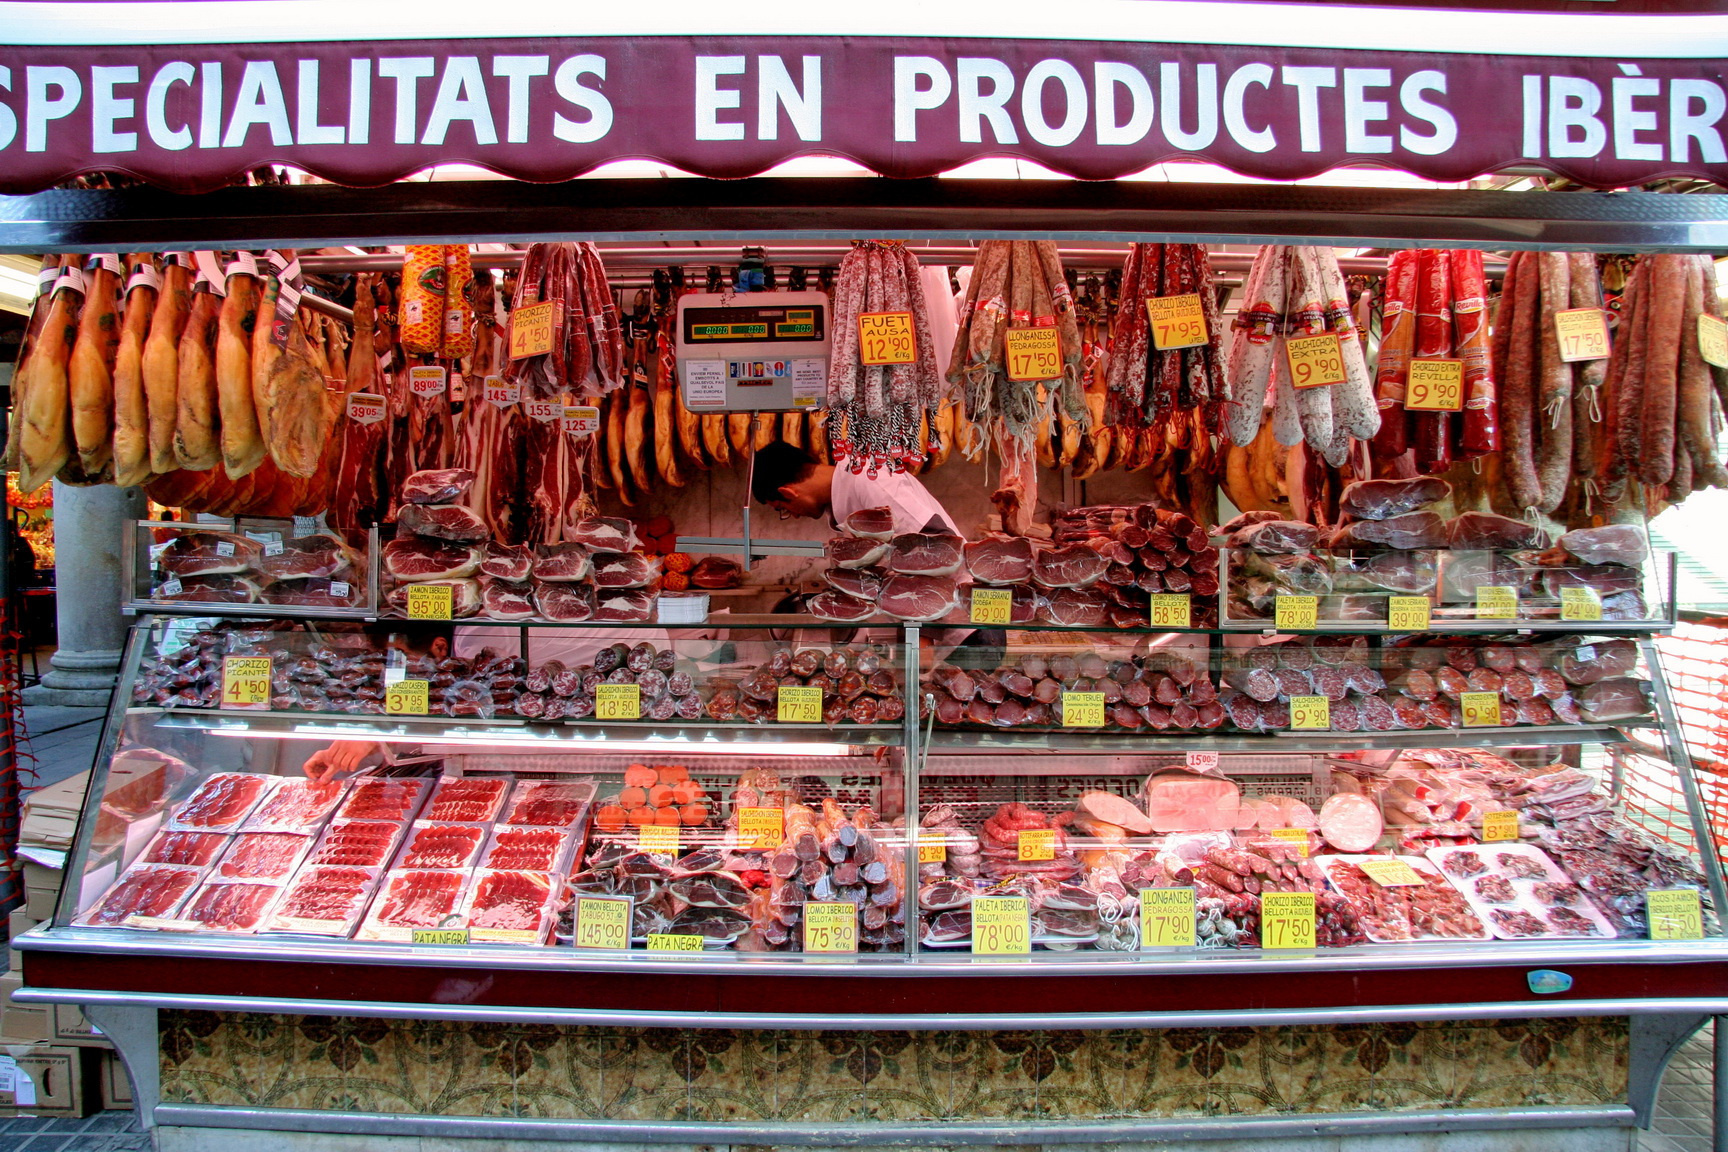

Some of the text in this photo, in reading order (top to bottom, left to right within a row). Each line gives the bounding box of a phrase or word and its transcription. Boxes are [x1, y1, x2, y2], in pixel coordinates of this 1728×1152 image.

[695, 55, 822, 141] EN
[894, 56, 1458, 156] PRODUCTES
[1150, 298, 1175, 310] CHORIZO
[514, 304, 551, 320] CHORIZO
[1152, 310, 1175, 321] BELLOTA
[515, 315, 549, 328] PICANTE
[862, 316, 908, 329] FUET
[866, 327, 910, 337] AUSA
[1009, 331, 1056, 342] LLONGANISSA
[1158, 321, 1201, 345] 7'95
[516, 326, 549, 352] 4'50
[1289, 337, 1336, 351] SALCHICHON
[1564, 333, 1603, 355] 17'50
[868, 337, 910, 360] 12'90
[1010, 342, 1056, 350] PEDRAGOSSA
[894, 352, 910, 360] €/Kg
[1292, 348, 1337, 359] EXTRA
[1013, 353, 1057, 375] 17'50
[1296, 358, 1339, 383] 9'90
[1412, 363, 1460, 372] CHORIZO EXTRA
[1412, 373, 1459, 381] REVILLA
[414, 380, 437, 392] 89'00
[488, 390, 508, 401] 145
[1413, 385, 1457, 404] 9'90
[351, 406, 377, 418] 39'05
[530, 405, 551, 416] 155
[565, 420, 586, 431] 125
[973, 591, 1010, 600] JAMON SERRANO
[412, 600, 446, 614] 95'00
[1565, 602, 1596, 618] 24'00
[975, 607, 1006, 622] 29'00
[1154, 606, 1187, 624] 58'50
[1280, 611, 1312, 624] 78'00
[1393, 612, 1424, 627] 39'00
[226, 660, 270, 669] CHORIZO
[228, 679, 267, 700] 4'50
[408, 682, 426, 690] CASERO
[390, 694, 422, 711] 3'95
[1064, 694, 1103, 702] LOMO TERUEL
[600, 700, 634, 716] 18'50
[782, 703, 816, 719] 17'50
[1067, 709, 1100, 724] 24'95
[1294, 708, 1327, 726] 9'90
[1466, 706, 1498, 725] 9'90
[742, 828, 780, 845] 20'90
[1486, 824, 1514, 838] 8'90
[919, 846, 943, 861] 8'50
[1143, 891, 1193, 905] LLONGANISA
[1264, 896, 1290, 907] CHORIZO
[1671, 893, 1697, 902] JAMON
[581, 902, 627, 912] JAMON BELLOTA
[806, 905, 854, 914] LOMO IBERICO
[976, 900, 1026, 911] PALETA IBERICA
[1143, 906, 1193, 914] PEDRAGOSSA
[1264, 908, 1294, 916] BELLOTA
[1674, 904, 1698, 913] BELLOTA
[581, 911, 614, 921] JABUGO 5J
[976, 914, 1000, 922] BELLOTA
[1145, 916, 1190, 943] 17'90
[1266, 919, 1310, 945] 17'50
[1658, 913, 1697, 939] 4'50
[415, 932, 437, 944] PATA
[581, 923, 624, 944] 145'00
[810, 926, 852, 948] 75'90
[976, 924, 1024, 951] 78'00
[648, 936, 704, 951] PATA NEGRA
[835, 942, 850, 950] €/Kg
